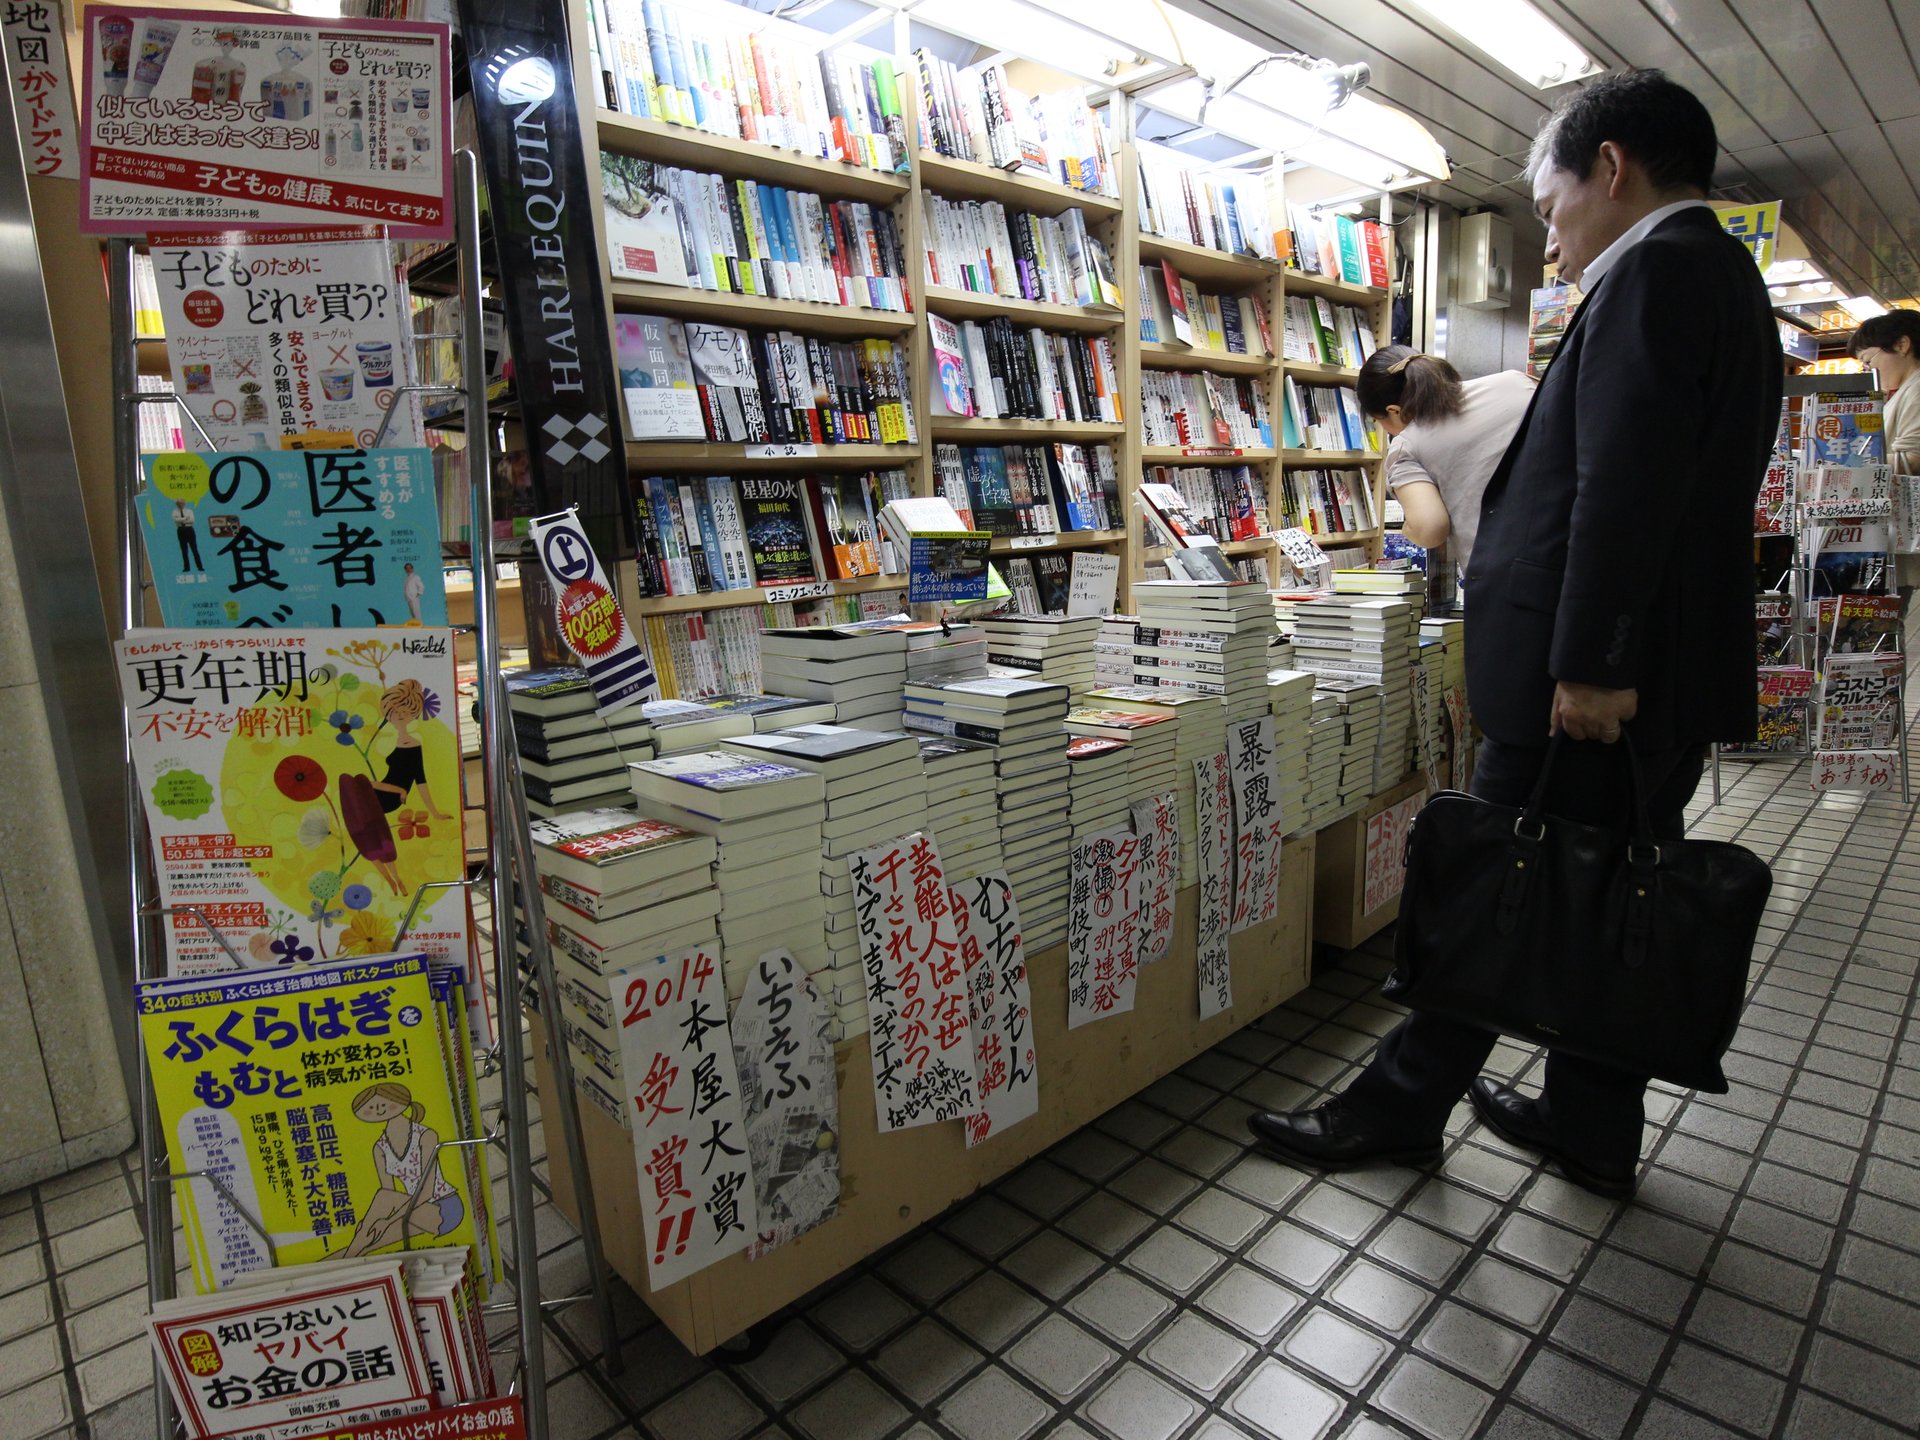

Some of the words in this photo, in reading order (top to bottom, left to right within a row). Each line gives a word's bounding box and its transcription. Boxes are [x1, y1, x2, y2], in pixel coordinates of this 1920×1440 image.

[97, 95, 270, 122] 似ているようで
[94, 207, 153, 217] 三才ブックス
[161, 250, 322, 290] 子どものために
[514, 98, 585, 395] HARLEQUIN
[374, 456, 396, 519] すすめる
[393, 455, 413, 503] 医者が
[741, 480, 799, 500] 星星の火
[977, 487, 1012, 505] 十字架
[1872, 468, 1888, 499] 東京
[1824, 526, 1863, 549] pen
[769, 583, 829, 603] コミックエッセイ
[1842, 606, 1900, 619] 奇天烈な絵画
[1844, 597, 1880, 606] ニッポンの
[565, 593, 616, 644] 100万部
[126, 650, 331, 709] 更年期の
[1834, 690, 1886, 705] カルディ
[1837, 677, 1887, 691] コストコ
[136, 706, 314, 742] 不安を解消!
[1234, 720, 1277, 828] 暴露
[1821, 753, 1865, 766] 担当者の
[1151, 797, 1173, 955] 東京五輪の
[1232, 831, 1254, 925] ファイル
[1069, 845, 1093, 1007] 歌舞伎町24時
[1116, 838, 1139, 985] タブー写真
[873, 849, 929, 1078] 干されるのか?
[908, 837, 969, 1051] 芸能人はなぜ
[142, 989, 224, 1015] 34の症状別
[225, 971, 341, 1000] ふくらはぎ治療地図
[342, 960, 421, 982] ポスター付録
[622, 952, 715, 1029] 2014
[971, 876, 1033, 1093] むちゃもん
[301, 1039, 410, 1070] 体が変わる!
[757, 956, 811, 1109] いちえふ
[193, 1062, 302, 1110] もむと
[304, 1058, 414, 1088] 病気が治る!
[680, 999, 747, 1245] 本屋大賞
[634, 1052, 697, 1265] 受賞!!
[218, 1297, 378, 1346] 知らないと
[254, 1327, 350, 1364] ヤバイ
[203, 1345, 396, 1410] お金の話
[277, 1420, 336, 1436] マイホーム
[347, 1413, 371, 1424] 年金
